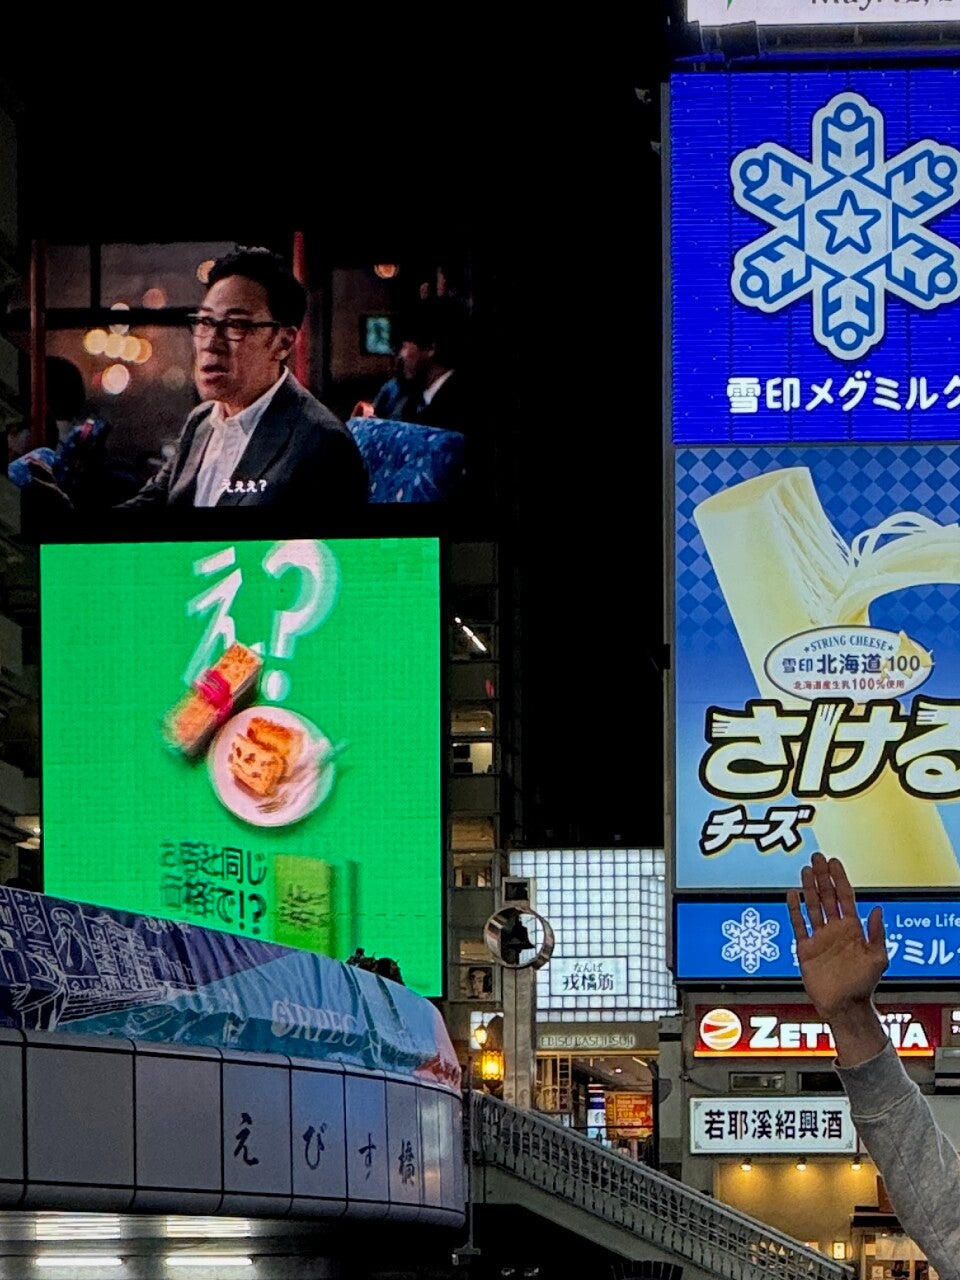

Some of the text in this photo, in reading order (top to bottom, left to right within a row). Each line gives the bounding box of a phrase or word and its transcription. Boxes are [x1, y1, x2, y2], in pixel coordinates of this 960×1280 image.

[810, 635, 888, 653] STRING CHEESE
[701, 804, 815, 855] チーズ
[896, 914, 932, 928] Love
[574, 962, 603, 973] なんば
[562, 972, 614, 991] 戎橋筋
